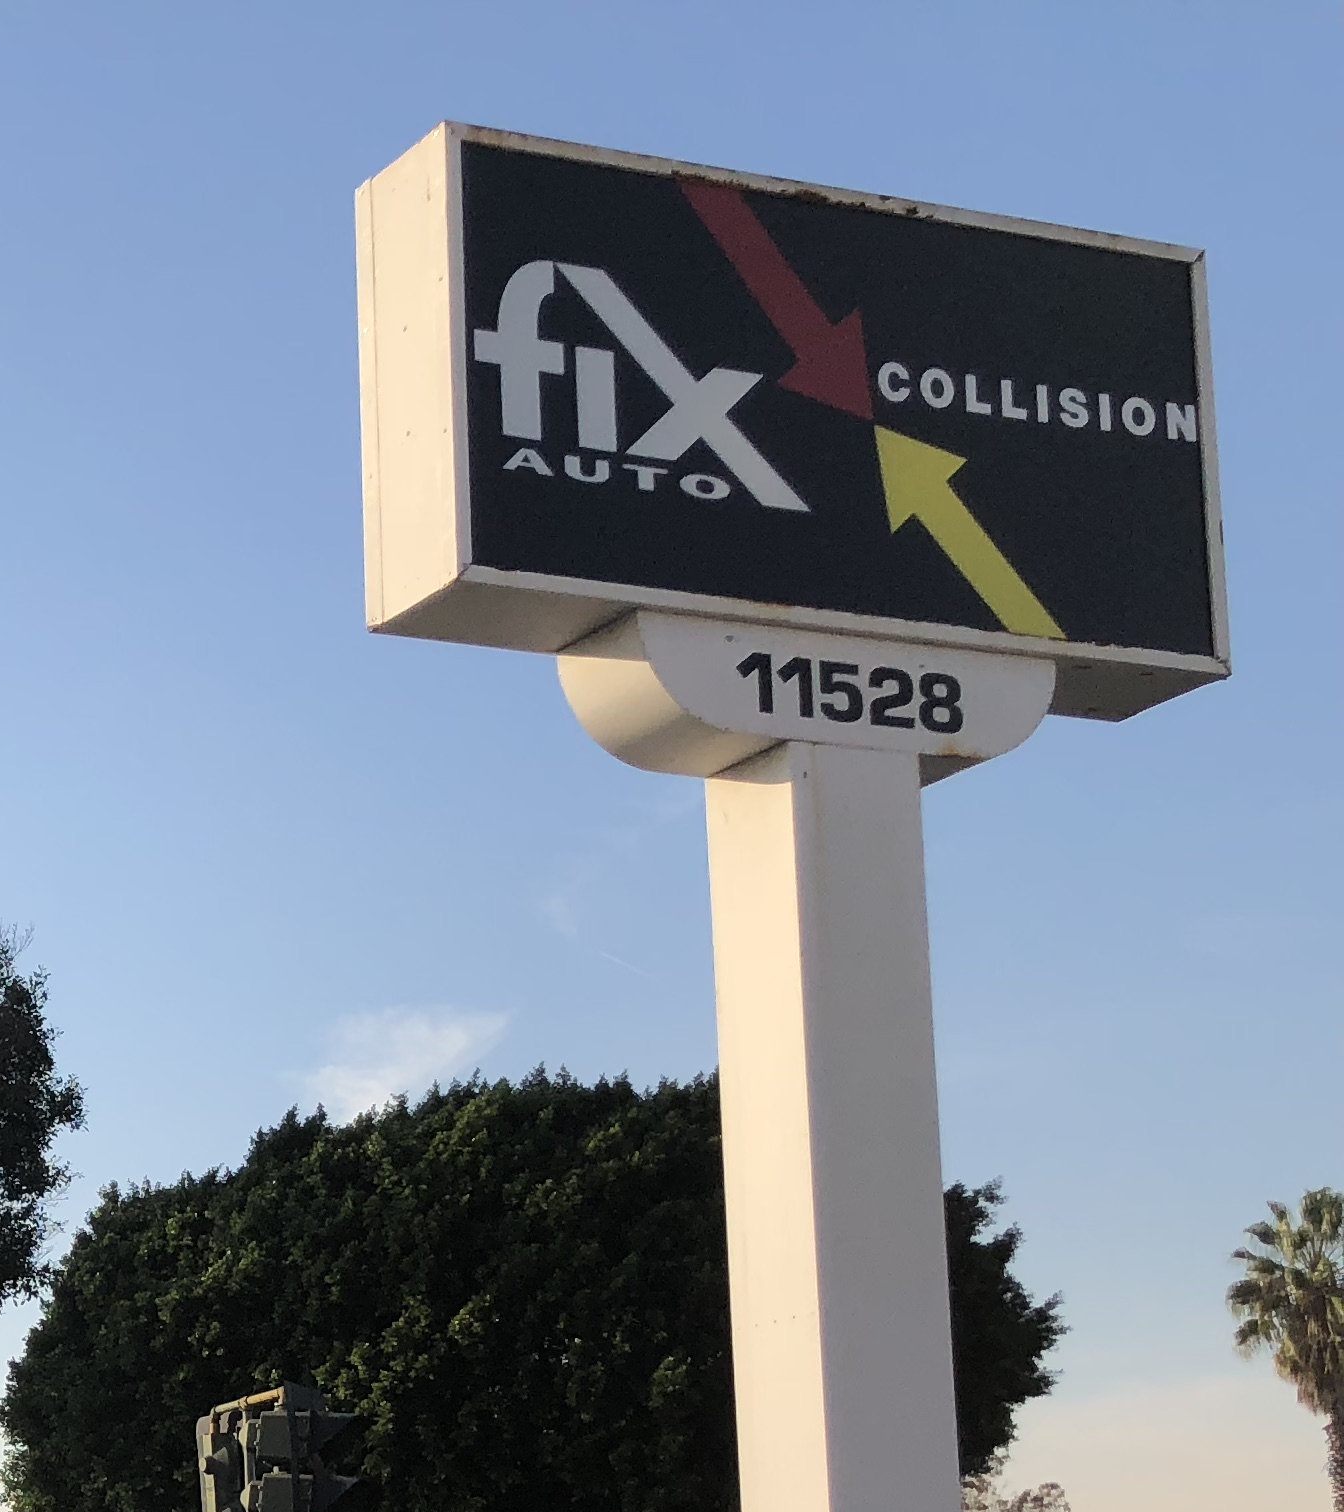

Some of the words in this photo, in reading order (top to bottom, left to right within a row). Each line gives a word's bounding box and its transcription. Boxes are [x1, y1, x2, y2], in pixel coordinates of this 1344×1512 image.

[474, 260, 811, 512] fix
[878, 361, 1197, 442] COLLISION
[503, 448, 730, 500] AUTO
[736, 653, 964, 734] 11528
